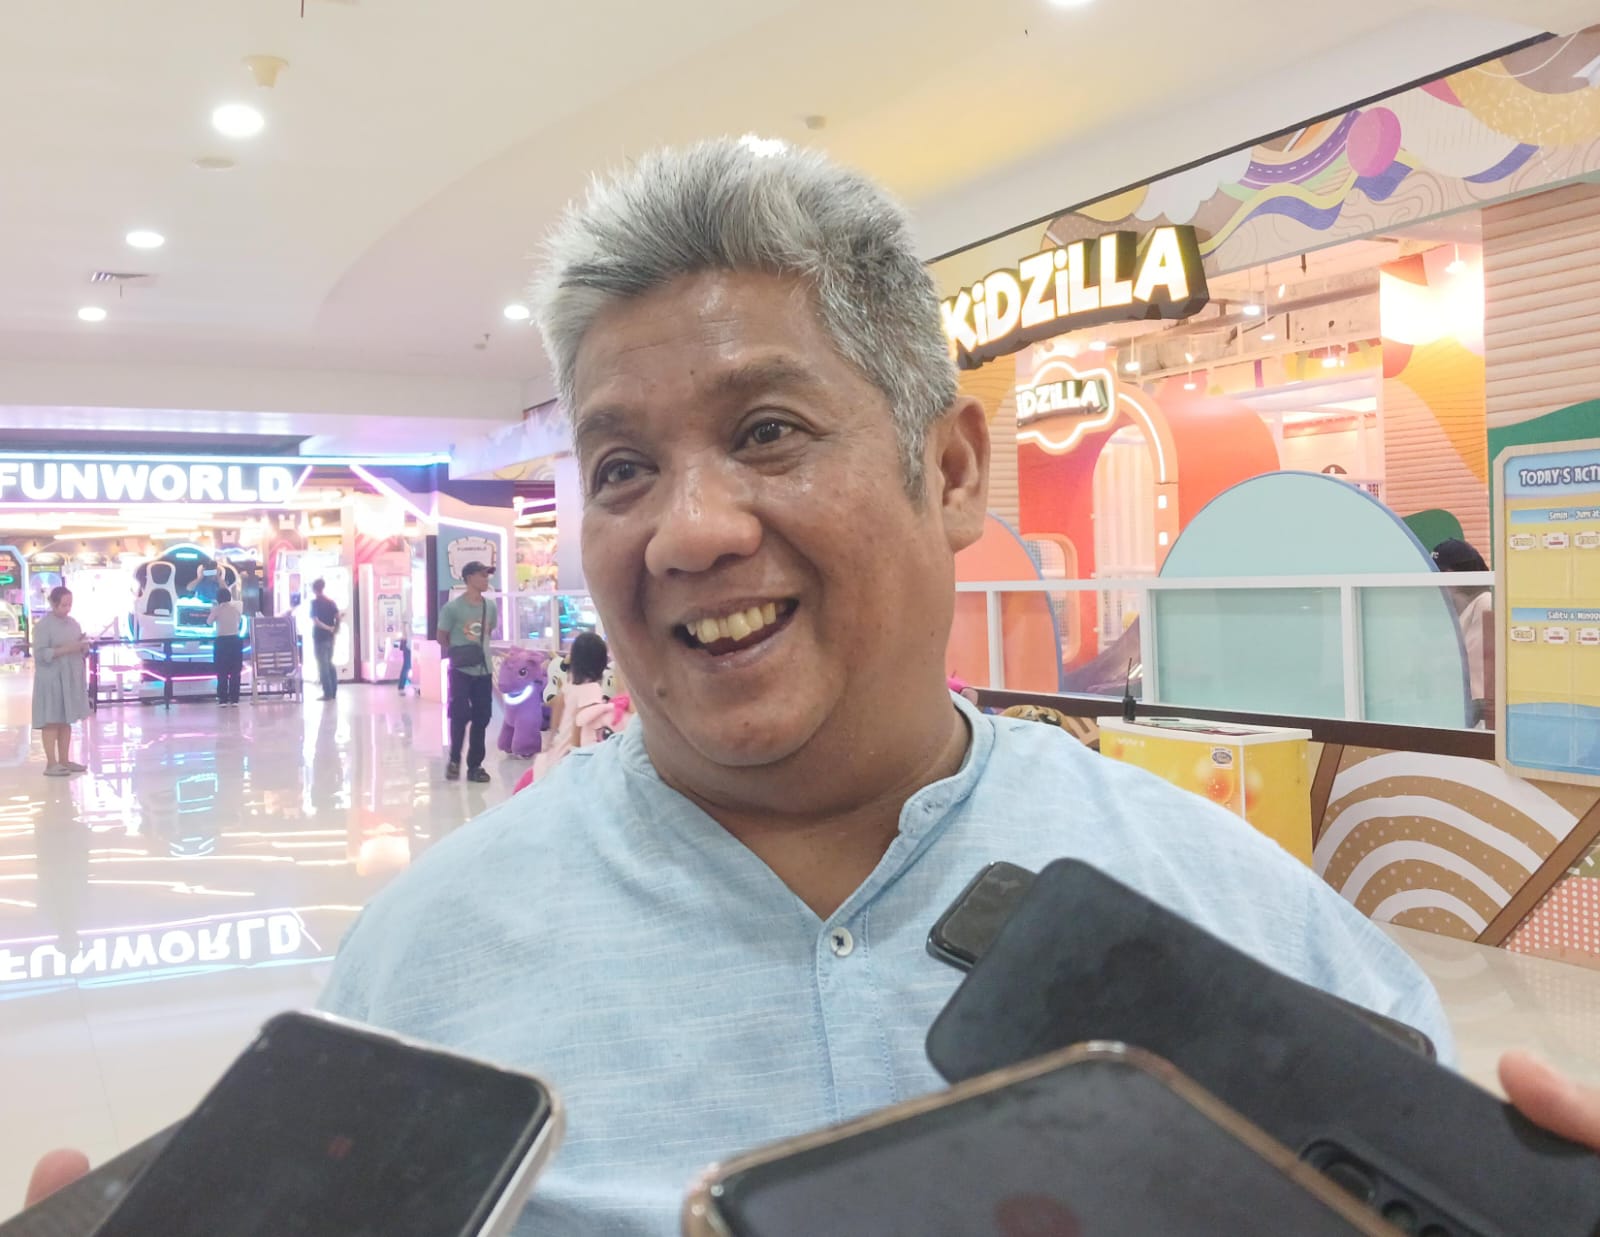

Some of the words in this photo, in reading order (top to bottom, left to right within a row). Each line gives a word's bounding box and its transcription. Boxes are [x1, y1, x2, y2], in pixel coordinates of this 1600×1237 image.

[1016, 380, 1101, 421] iDZiLLA
[0, 463, 293, 502] FUNWORLD
[1520, 467, 1571, 486] TODAY'S
[1577, 611, 1600, 621] Mingg
